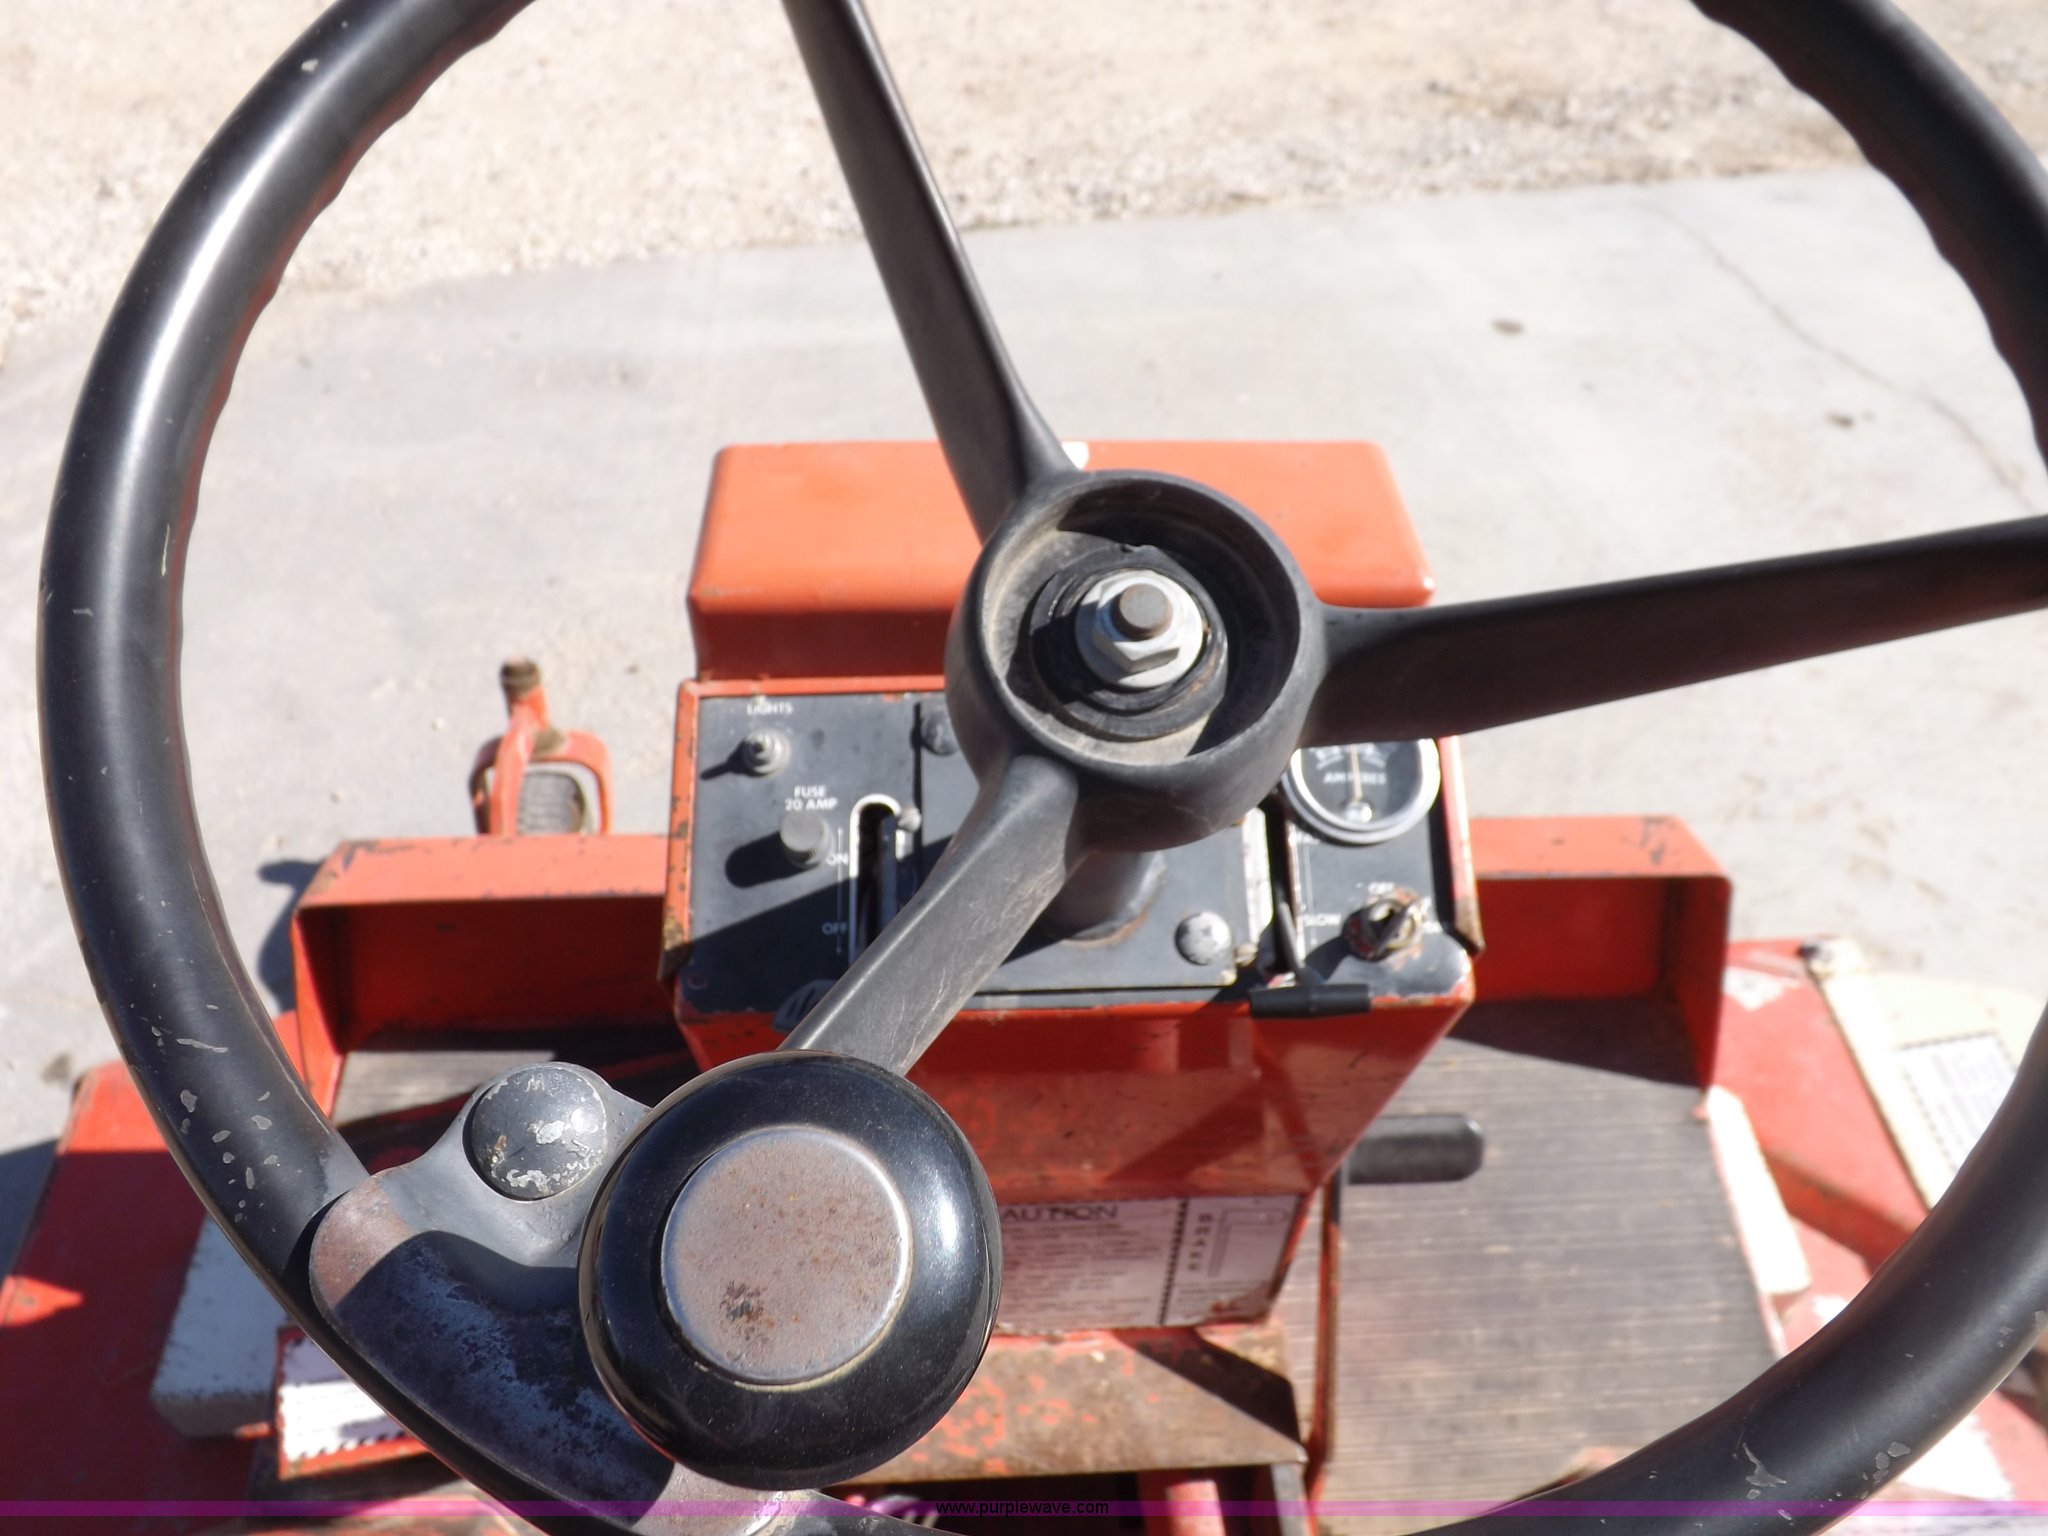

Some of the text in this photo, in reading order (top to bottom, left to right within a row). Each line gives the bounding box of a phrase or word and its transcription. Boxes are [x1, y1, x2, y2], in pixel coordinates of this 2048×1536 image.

[746, 701, 794, 715] LIGHTS
[793, 785, 827, 798] FUSE
[784, 797, 839, 811] 20 AMP
[821, 921, 848, 935] OFF
[1001, 1204, 1119, 1223] AUTION
